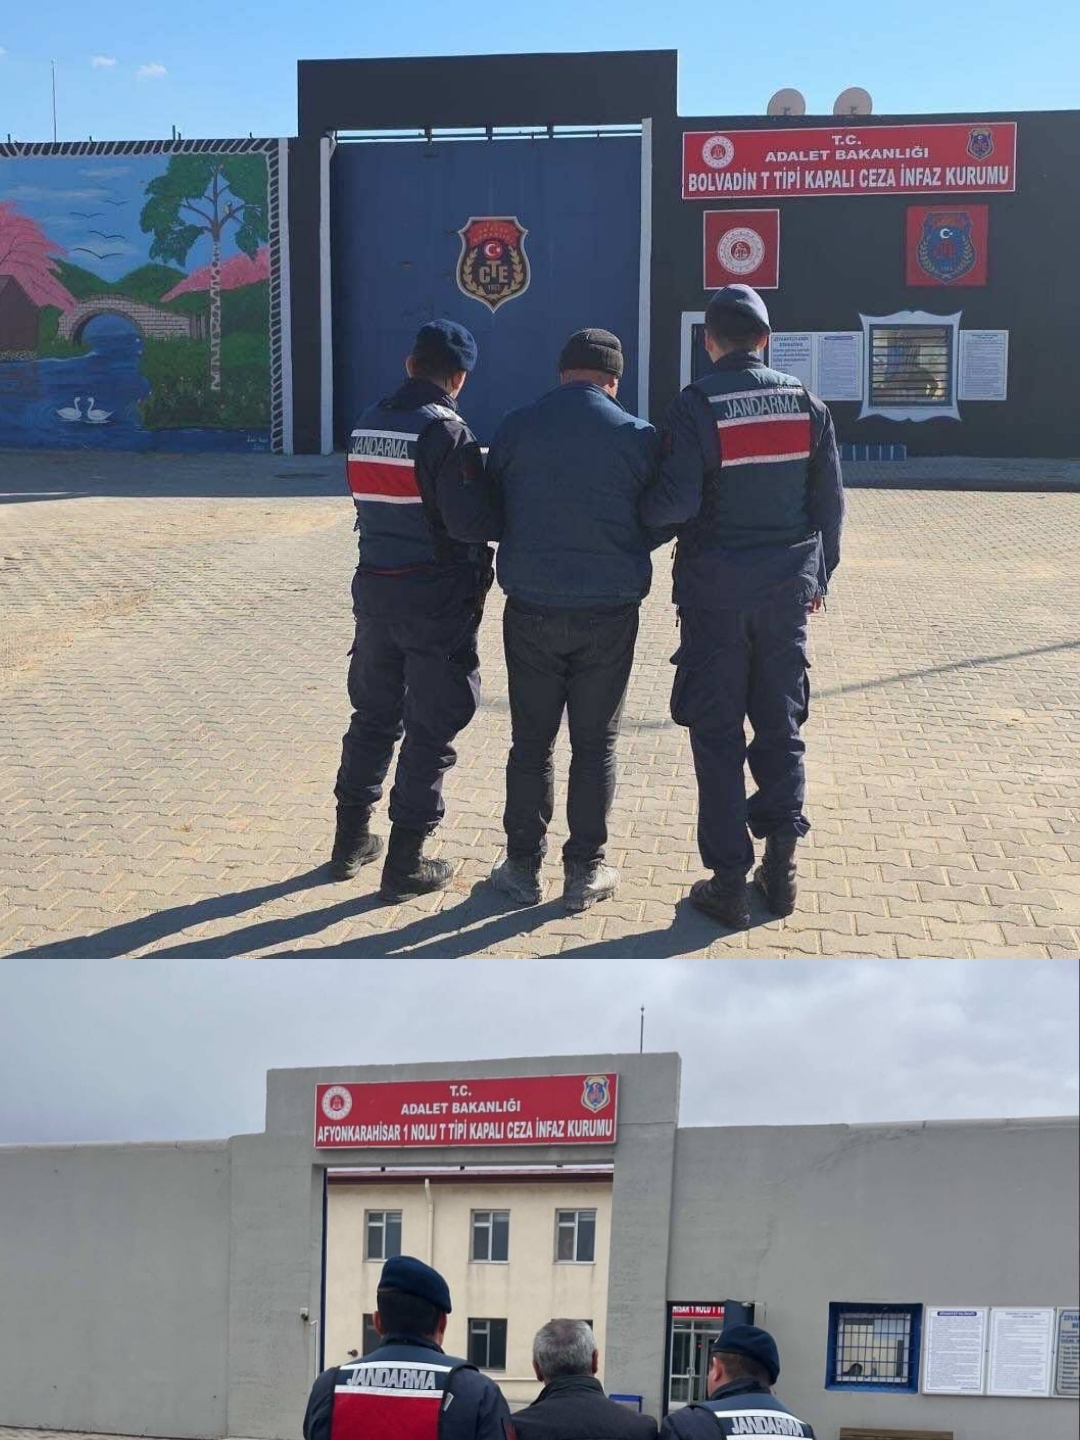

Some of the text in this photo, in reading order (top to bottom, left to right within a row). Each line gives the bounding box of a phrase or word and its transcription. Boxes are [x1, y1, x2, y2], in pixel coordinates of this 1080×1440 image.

[832, 135, 861, 145] T.C.
[765, 146, 928, 162] ADALET BAKANLIĞI
[688, 164, 1009, 192] BOLVADİN T TİPİ KAPALI CEZA İNFAZ KURUMU
[725, 394, 801, 419] JANDARMA
[352, 436, 408, 460] JANDARMA
[450, 1085, 472, 1097] T.C.
[401, 1098, 520, 1115] ADALET BAKANLIĞI
[318, 1117, 612, 1142] AFYONKARAHİSAR 1 NOLU T TİPİ KAPALI CEZA İNFAZ KURUMU
[347, 1368, 436, 1390] JANDARMA
[732, 1416, 804, 1437] JANDARMA
